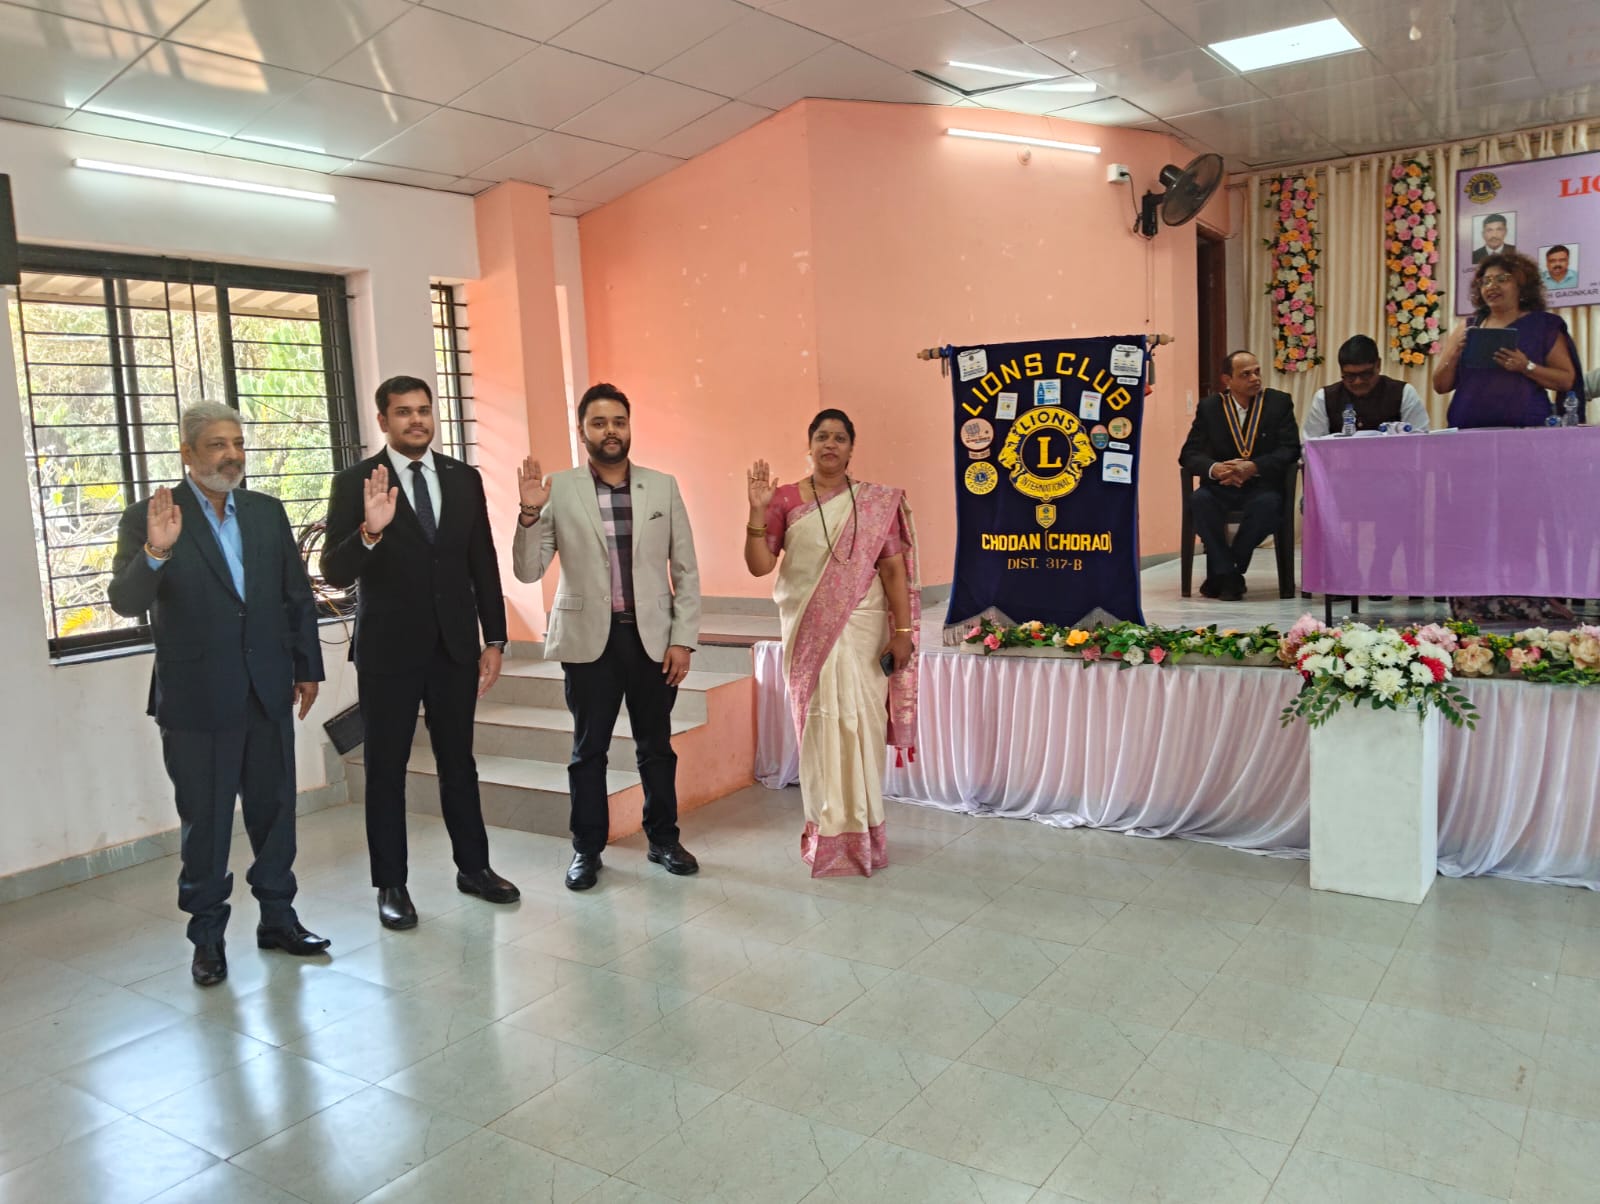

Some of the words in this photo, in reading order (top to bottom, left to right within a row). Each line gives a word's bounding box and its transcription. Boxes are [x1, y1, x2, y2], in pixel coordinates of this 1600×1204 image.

[961, 352, 1043, 416] LIONS
[1056, 352, 1132, 411] CLUB
[1020, 411, 1075, 431] LIONS
[1037, 436, 1062, 468] L
[1021, 477, 1071, 493] INTERNATIONAL
[981, 533, 1041, 551] CHODAN
[1008, 558, 1039, 570] DIST.
[1045, 558, 1082, 571] 317-B
